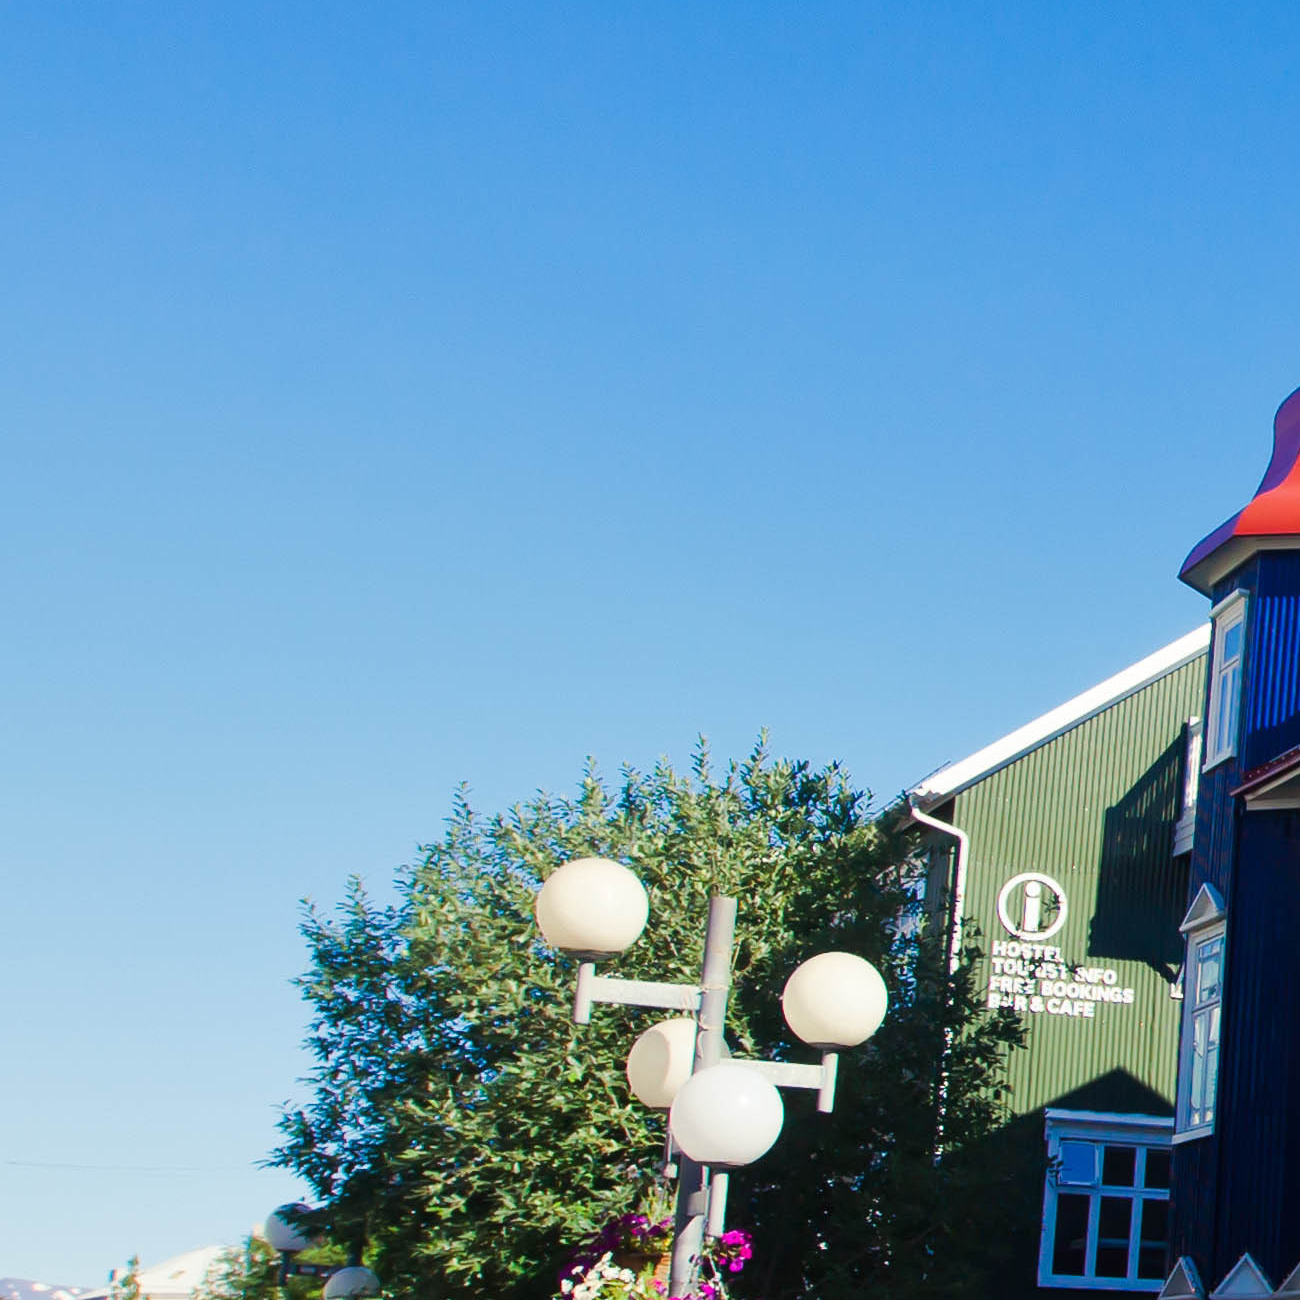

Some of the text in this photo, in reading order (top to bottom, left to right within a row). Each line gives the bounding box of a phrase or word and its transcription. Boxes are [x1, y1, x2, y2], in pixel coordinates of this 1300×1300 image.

[1040, 980, 1135, 1004] BOOKINGS
[1029, 995, 1045, 1013] &
[1046, 997, 1096, 1018] CAFE
